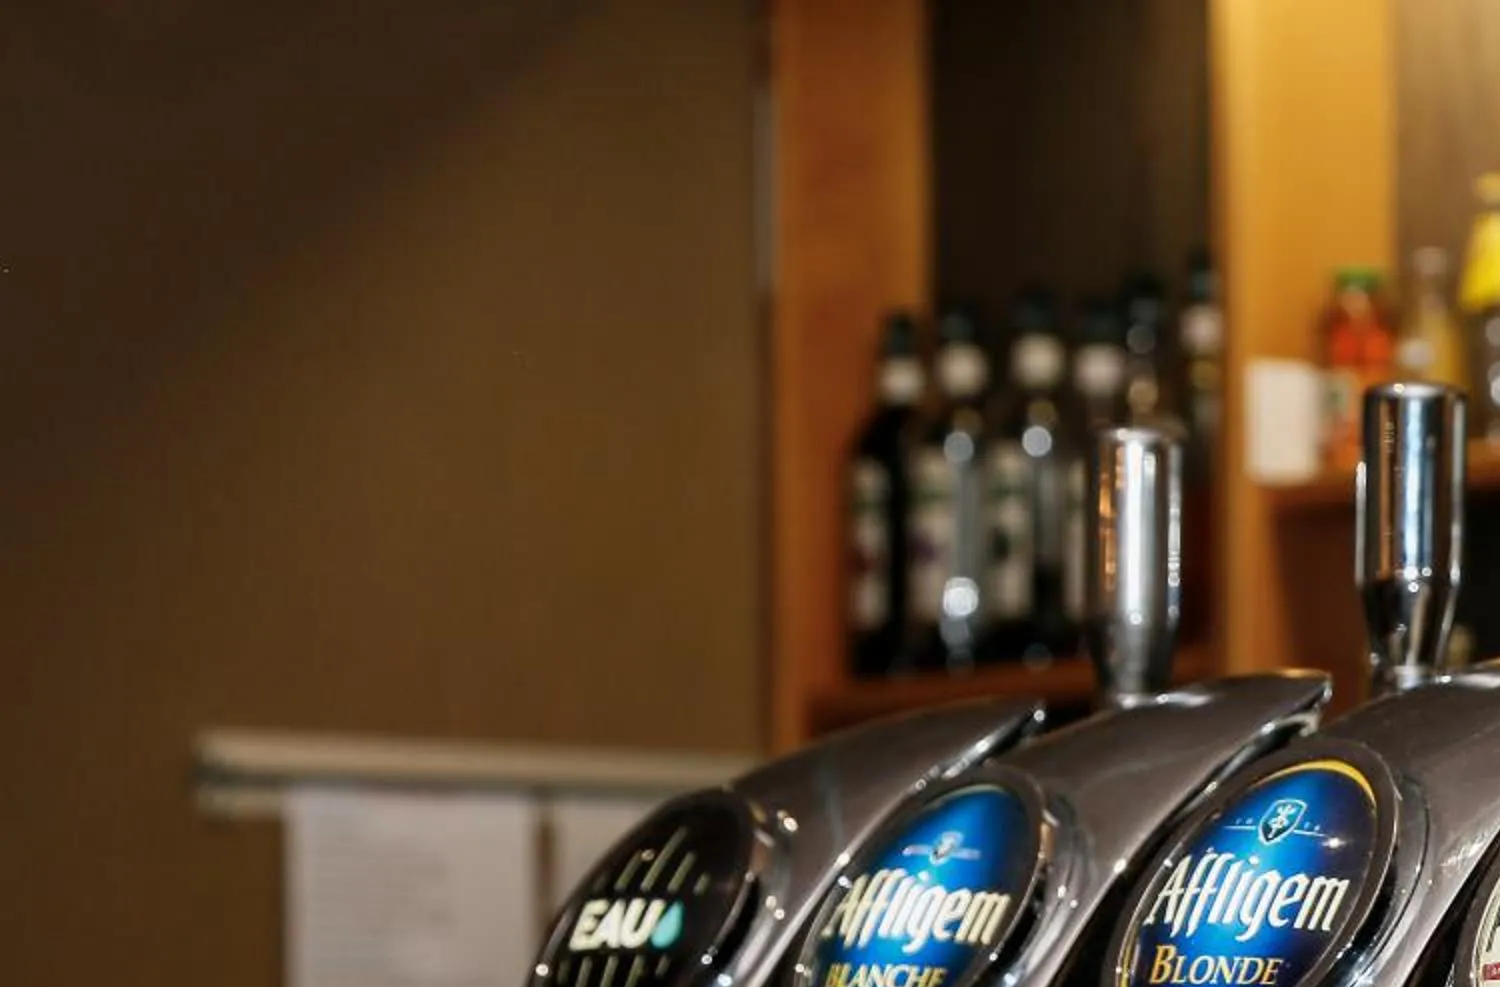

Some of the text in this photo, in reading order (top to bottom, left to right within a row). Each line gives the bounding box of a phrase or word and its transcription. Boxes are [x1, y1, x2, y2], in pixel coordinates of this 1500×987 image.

[569, 898, 668, 950] EAU
[820, 868, 1011, 954] Affligem
[1142, 848, 1350, 942] Affligem
